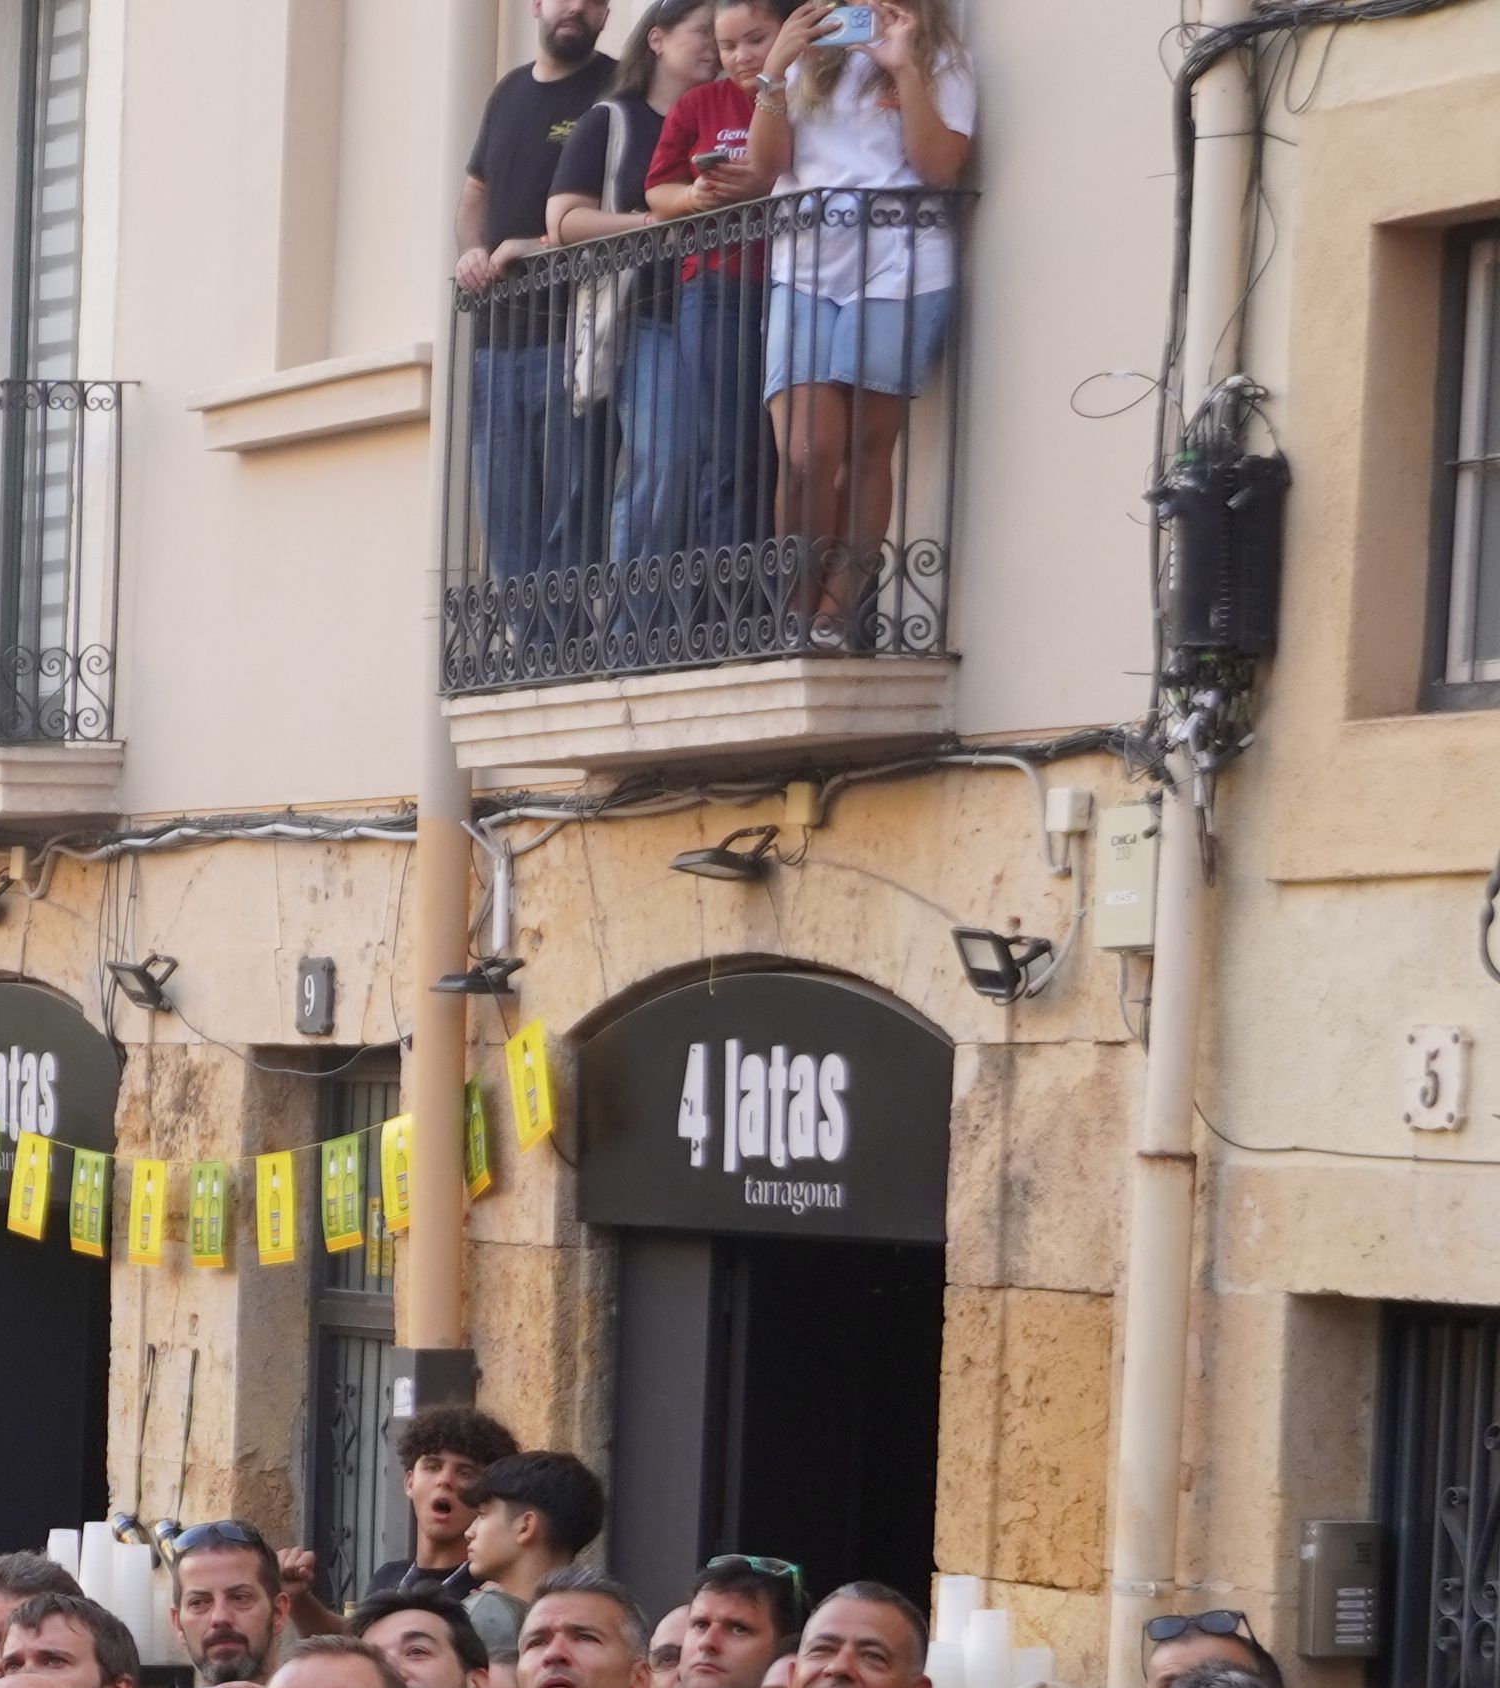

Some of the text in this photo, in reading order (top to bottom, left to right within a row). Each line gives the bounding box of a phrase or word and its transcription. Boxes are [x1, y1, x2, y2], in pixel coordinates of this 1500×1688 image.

[304, 974, 315, 1017] 9
[1419, 1047, 1441, 1109] 5
[678, 1038, 846, 1172] 4 latas
[744, 1174, 842, 1215] tarragona
